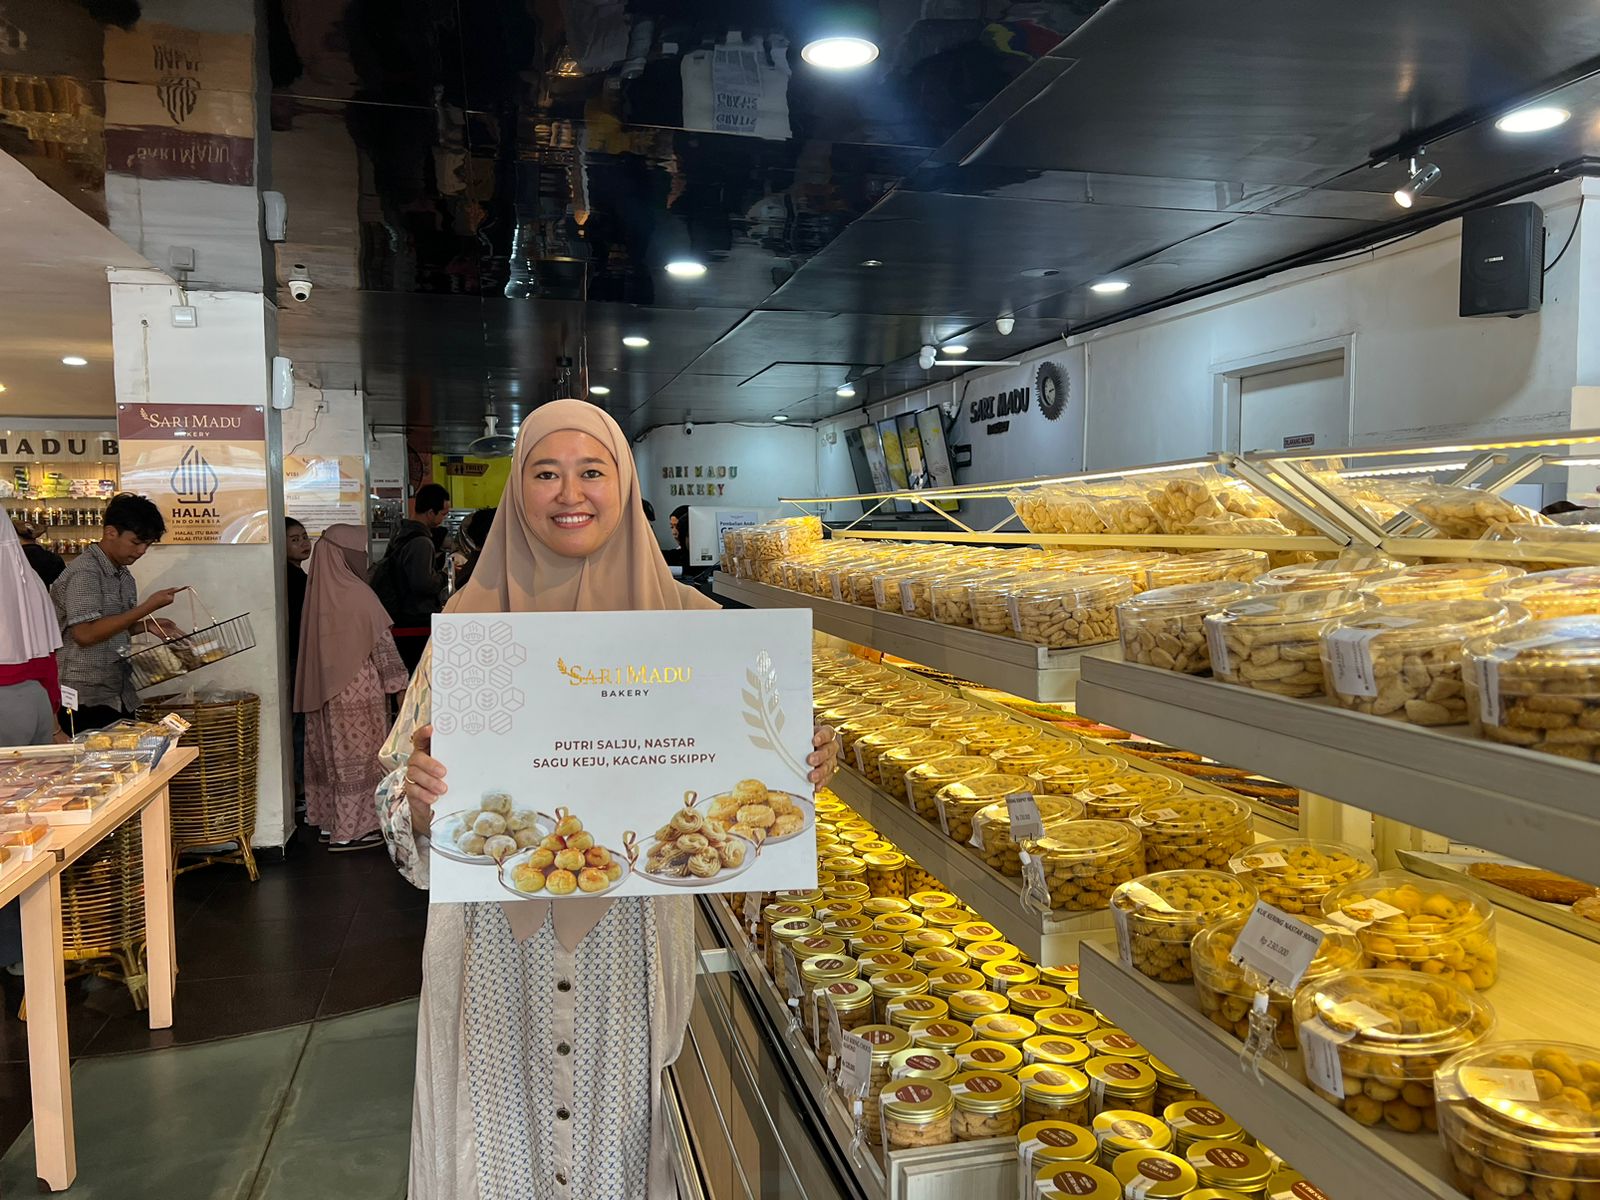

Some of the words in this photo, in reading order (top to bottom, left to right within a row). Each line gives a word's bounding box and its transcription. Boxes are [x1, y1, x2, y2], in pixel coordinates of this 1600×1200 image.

[970, 396, 995, 423] SARI
[997, 387, 1030, 417] MADU
[149, 413, 188, 428] SARI
[192, 415, 241, 428] MADU
[662, 466, 689, 478] SARI
[695, 466, 738, 478] MADU
[670, 484, 725, 496] BAKERY
[172, 508, 220, 518] HALAL
[569, 665, 622, 686] SARI
[627, 664, 693, 685] MADU
[601, 689, 650, 698] BAKERY
[555, 740, 593, 751] PUTRI
[597, 739, 641, 750] SALJU,
[644, 737, 696, 749] NASTAR
[533, 757, 569, 768] SAGU
[573, 756, 610, 768] KEJU,
[613, 754, 667, 766] KACANG
[670, 752, 717, 764] SKIPPY
